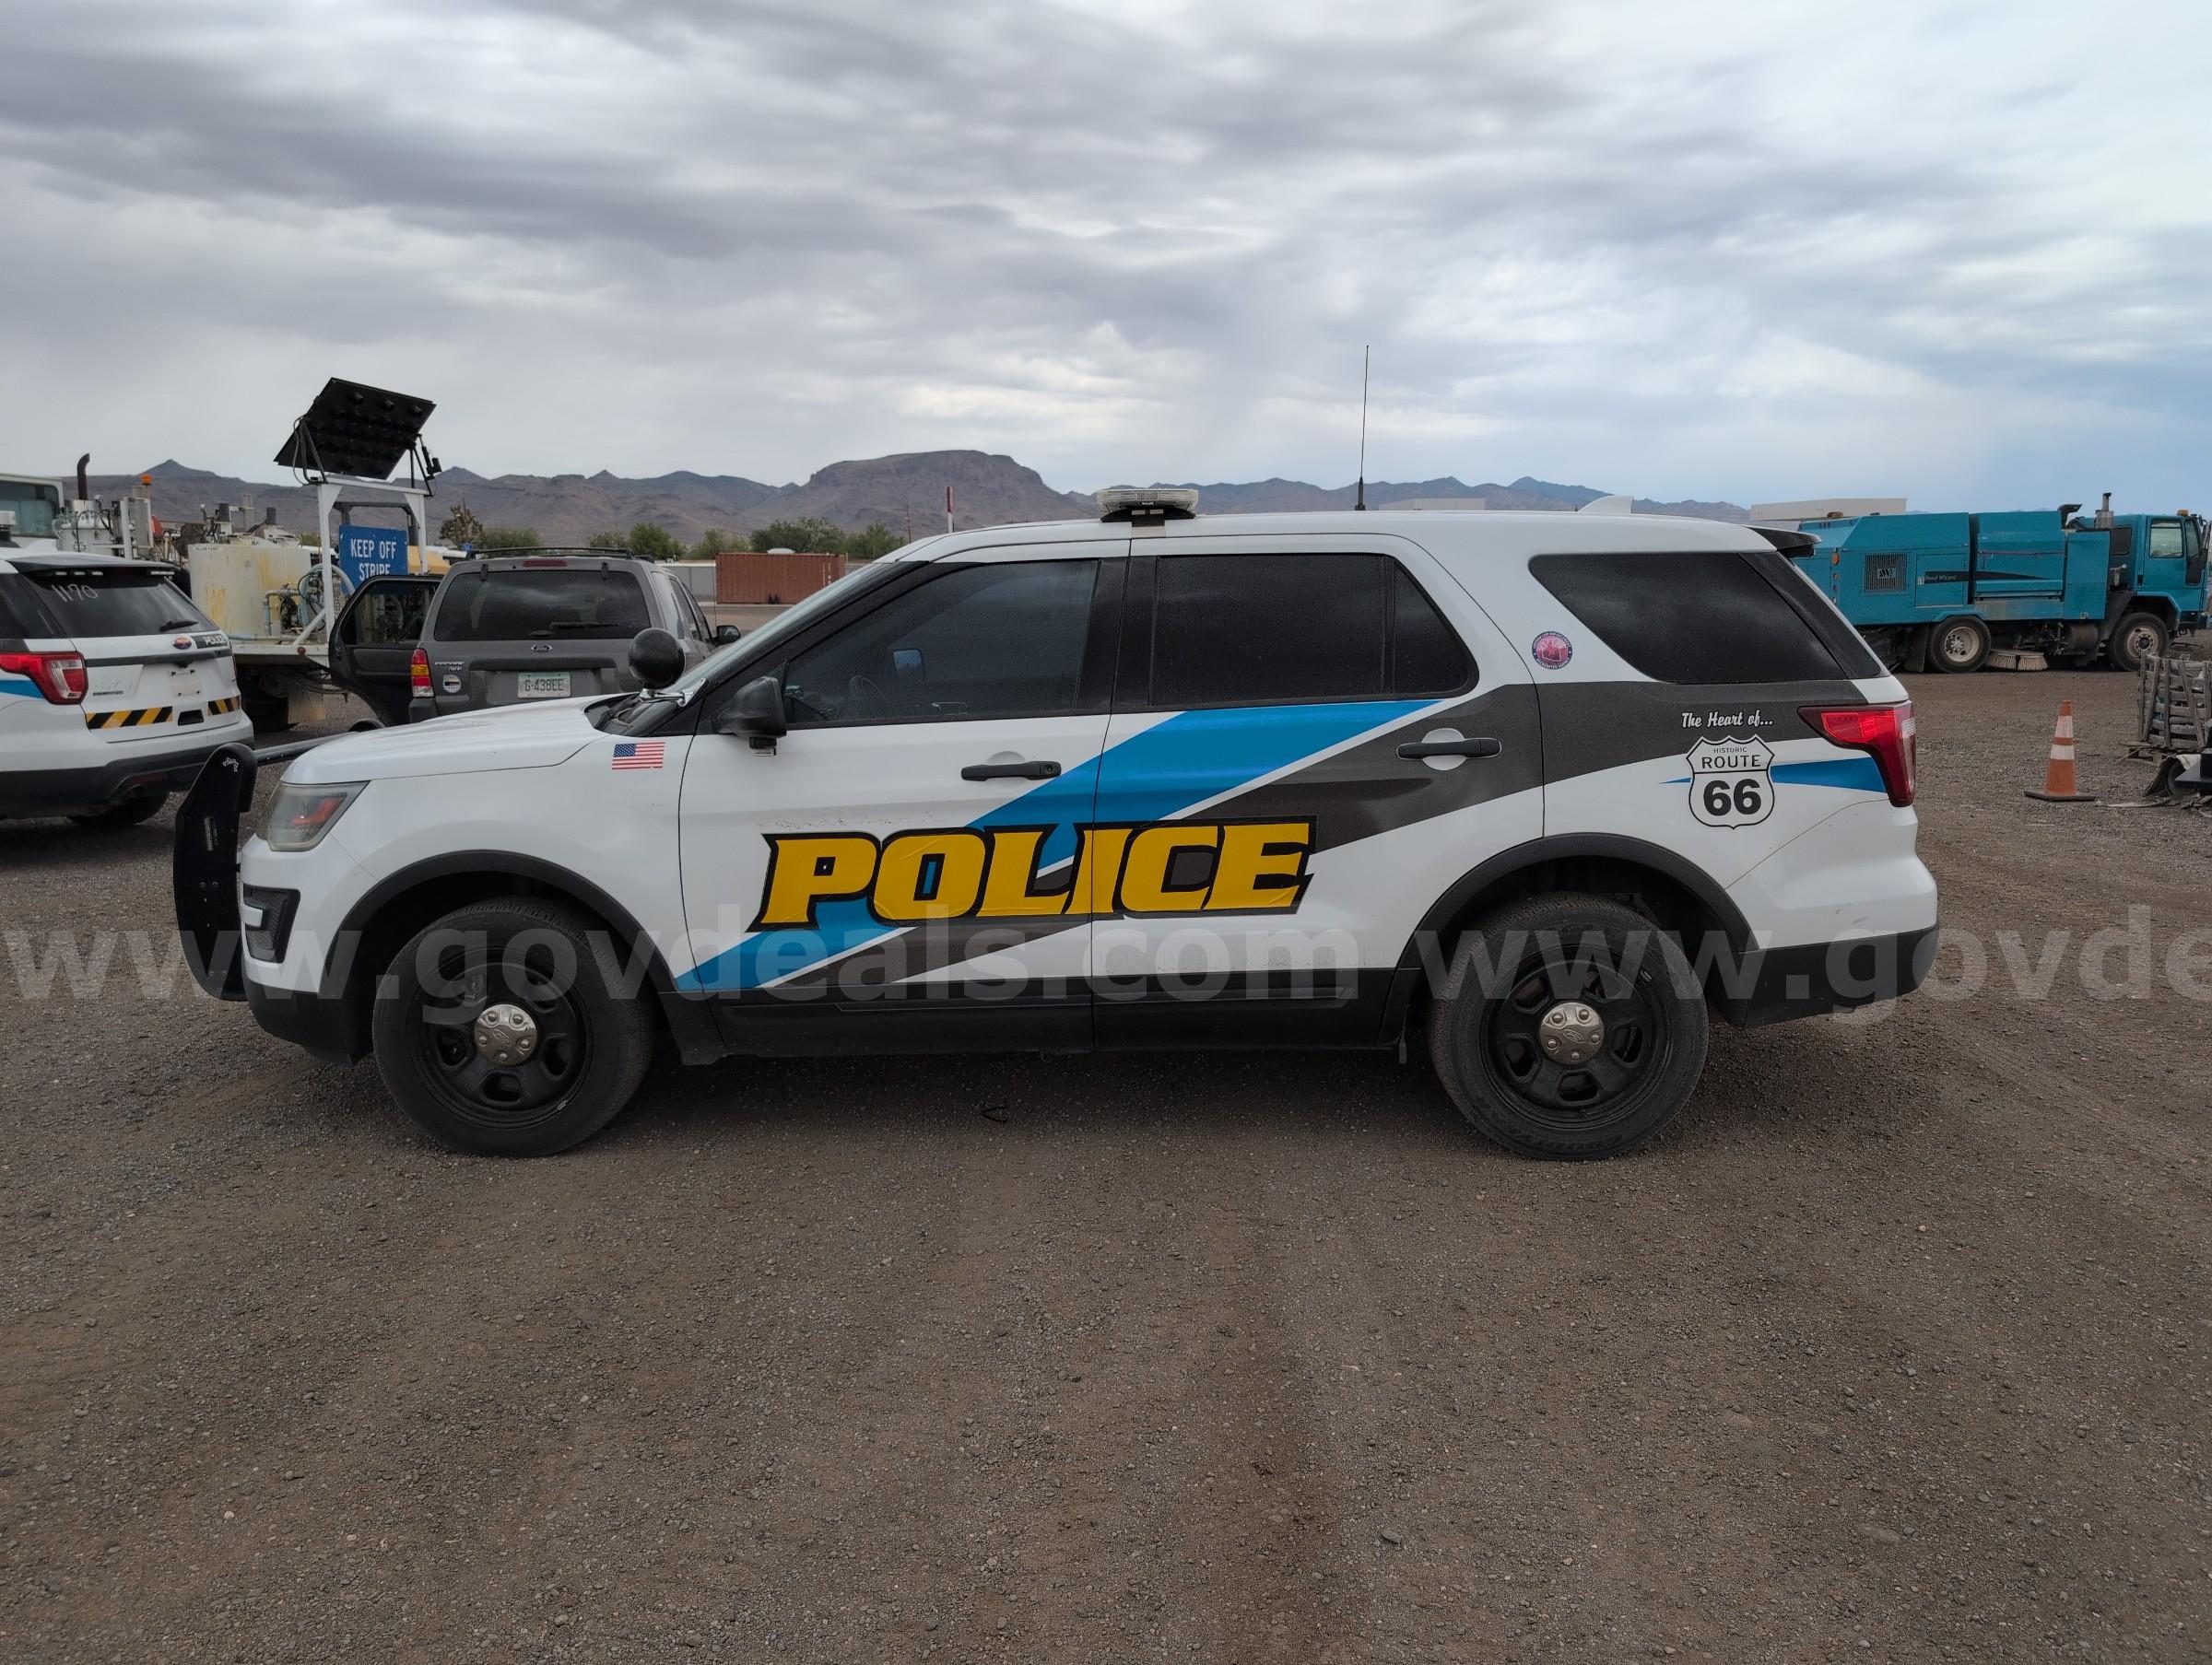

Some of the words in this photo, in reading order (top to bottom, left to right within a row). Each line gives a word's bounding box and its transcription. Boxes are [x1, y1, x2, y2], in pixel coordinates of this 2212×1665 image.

[350, 538, 375, 558] KEEP
[379, 540, 397, 559] OFF
[1682, 712, 1702, 728] The
[1707, 711, 1743, 727] Heart
[1747, 709, 1773, 727] of...
[1701, 756, 1761, 768] ROUTE
[1703, 779, 1761, 816] 66
[747, 815, 1318, 932] POLICE
